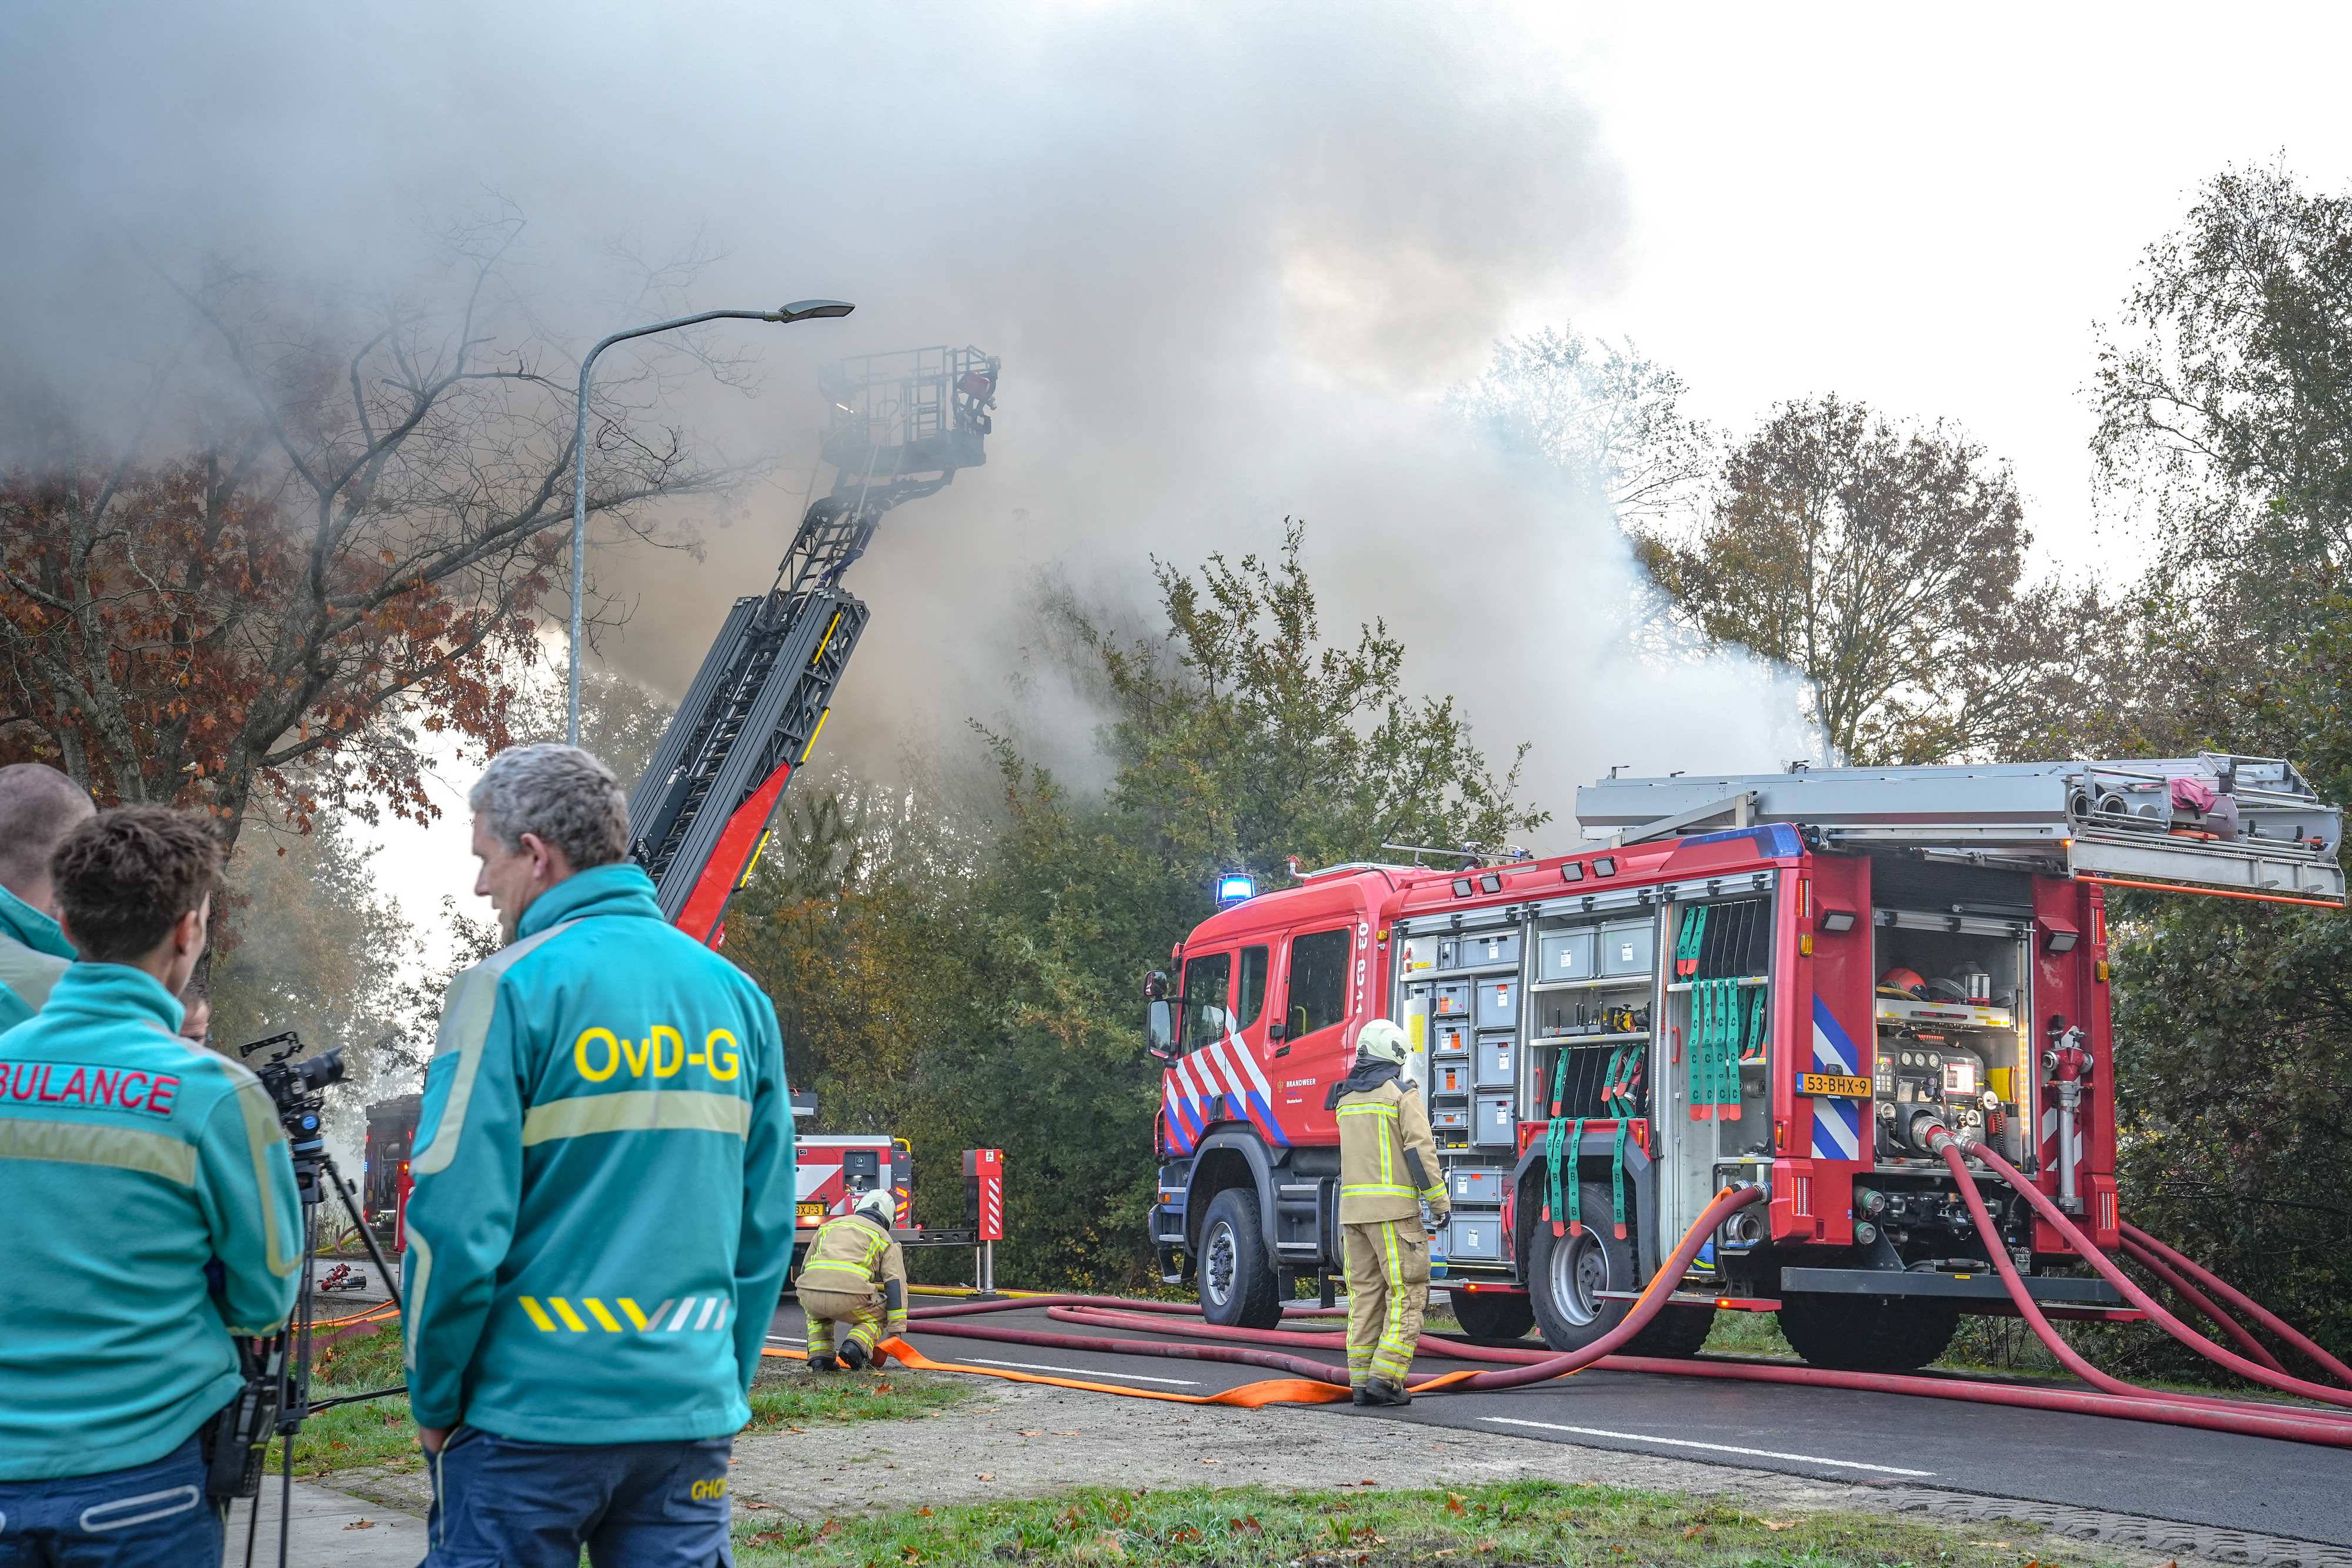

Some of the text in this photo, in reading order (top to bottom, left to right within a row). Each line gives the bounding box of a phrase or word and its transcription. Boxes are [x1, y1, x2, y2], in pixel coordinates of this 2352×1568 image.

[1688, 913, 1692, 922] C
[1699, 913, 1704, 922] C
[1680, 945, 1685, 955] C
[1691, 945, 1696, 955] C
[1693, 983, 1698, 993] C
[1705, 982, 1709, 992] C
[1718, 981, 1723, 991] C
[1730, 981, 1735, 990] C
[1755, 1001, 1759, 1009] C
[1693, 1019, 1698, 1029] C
[1706, 1018, 1710, 1028] C
[1718, 1017, 1723, 1027] C
[1731, 1017, 1736, 1027] C
[1750, 1036, 1755, 1045] C
[573, 1025, 739, 1082] OvD-G
[1705, 1054, 1711, 1063] C
[1717, 1053, 1723, 1062] C
[1730, 1052, 1736, 1062] C
[1560, 1055, 1565, 1064] B
[1692, 1054, 1697, 1064] C
[1607, 1072, 1611, 1082] B
[1623, 1069, 1629, 1078] B
[1286, 1078, 1316, 1088] BRANDWEER
[1808, 1076, 1867, 1094] 53-BHX-9
[1556, 1088, 1559, 1096] B
[1693, 1090, 1699, 1099] C
[1707, 1089, 1712, 1099] C
[1719, 1089, 1725, 1099] C
[1732, 1089, 1738, 1099] C
[1547, 1139, 1552, 1148] B
[1556, 1139, 1561, 1148] B
[1573, 1139, 1578, 1148] B
[1616, 1139, 1622, 1148] B
[1553, 1173, 1558, 1182] B
[1571, 1172, 1575, 1181] B
[1615, 1173, 1620, 1183] B
[1554, 1206, 1560, 1216] B
[1571, 1206, 1577, 1216] B
[1616, 1209, 1622, 1218] B
[691, 1477, 727, 1501] GHO
